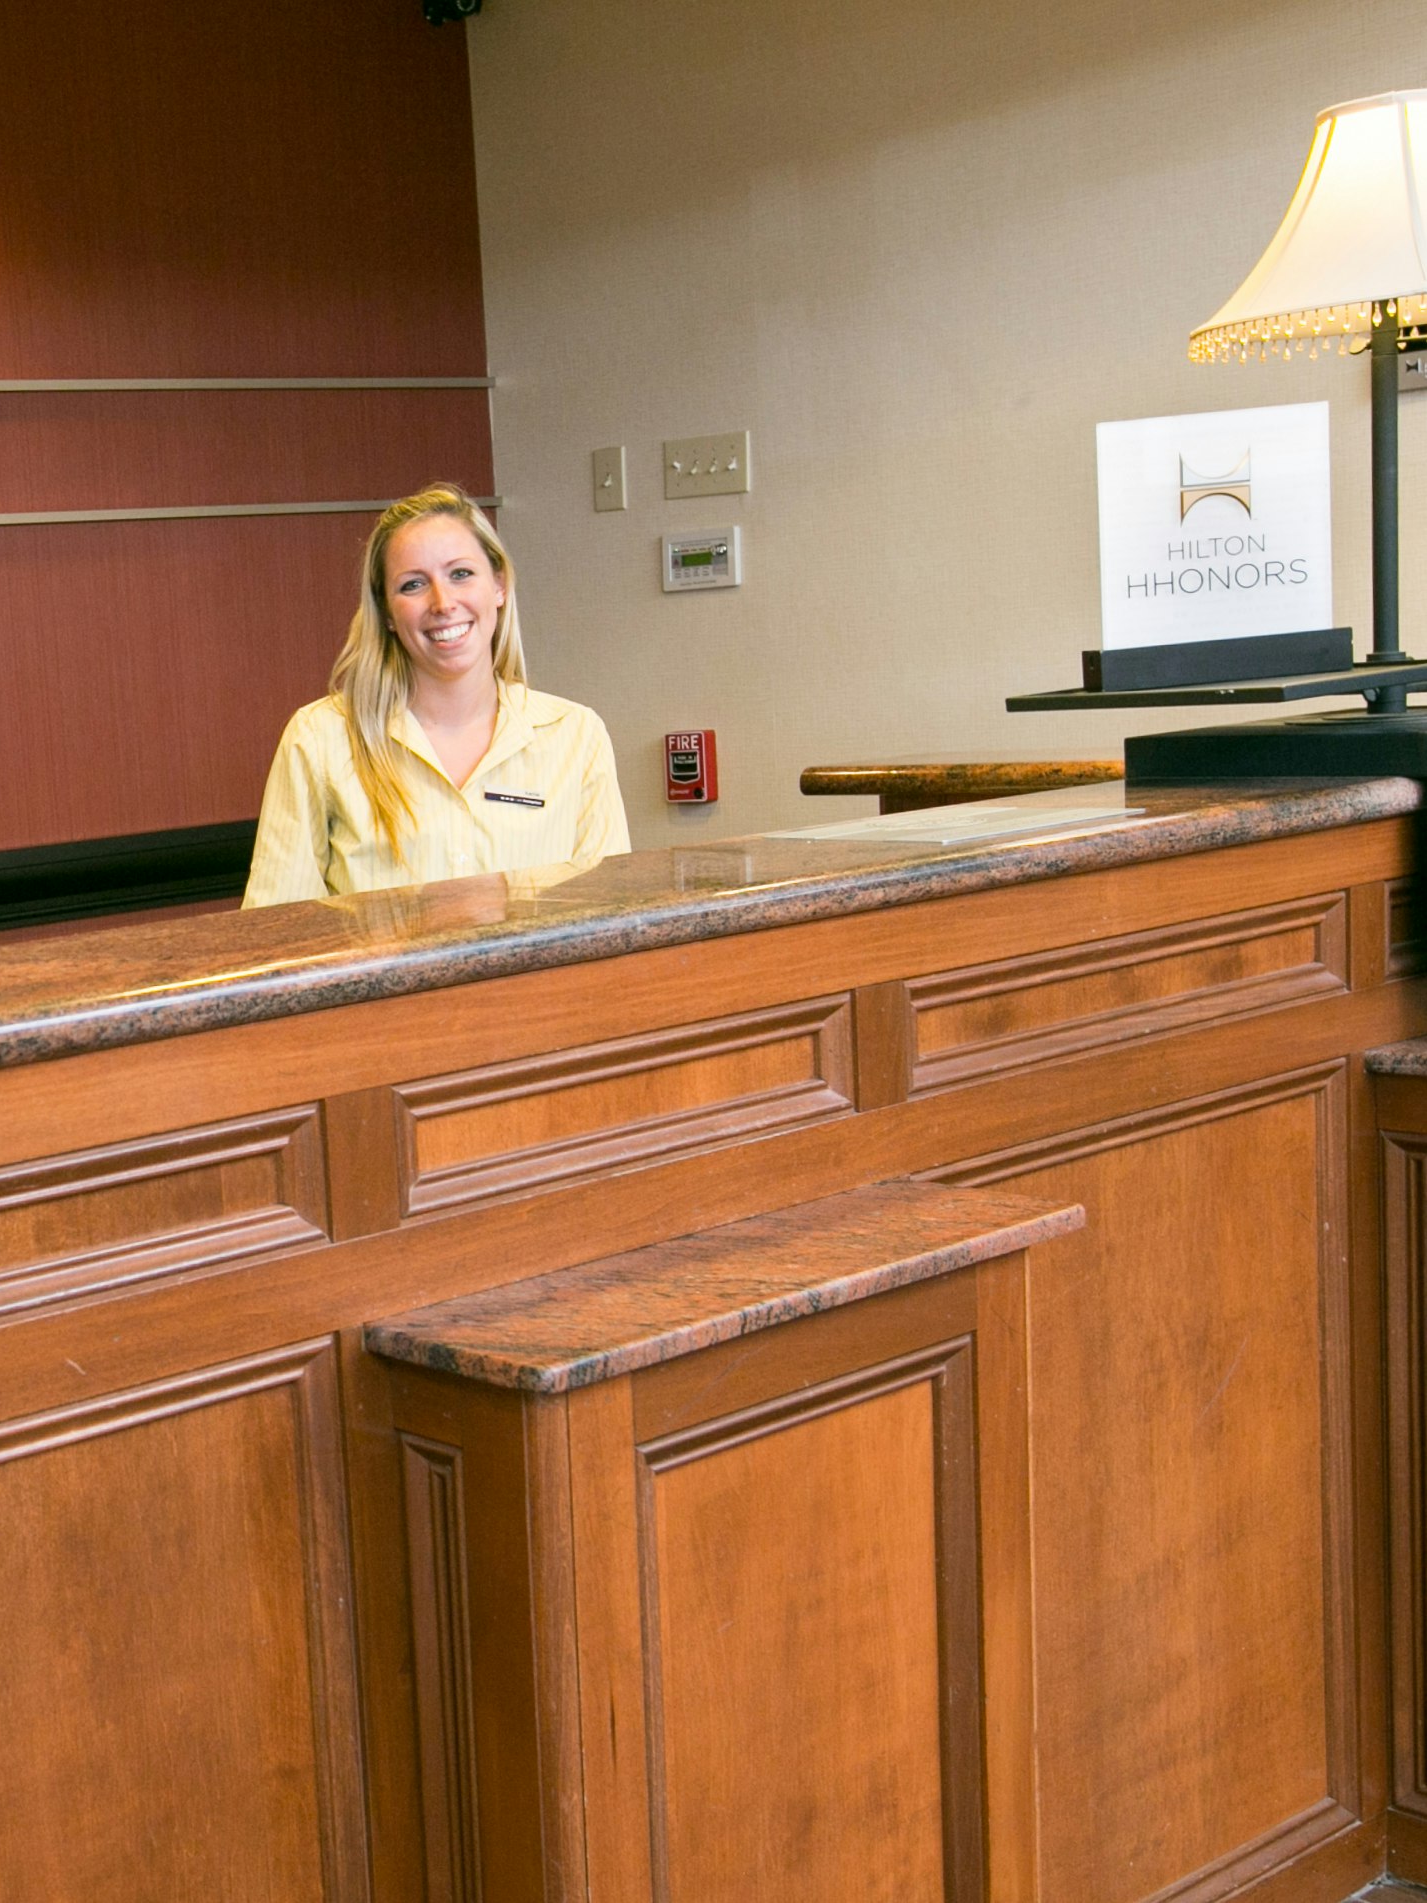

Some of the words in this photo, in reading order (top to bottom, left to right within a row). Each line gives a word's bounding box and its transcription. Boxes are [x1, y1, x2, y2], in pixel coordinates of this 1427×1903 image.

[1168, 533, 1266, 561] HILTON
[1127, 558, 1308, 599] HHONORS
[668, 734, 699, 750] FIRE
